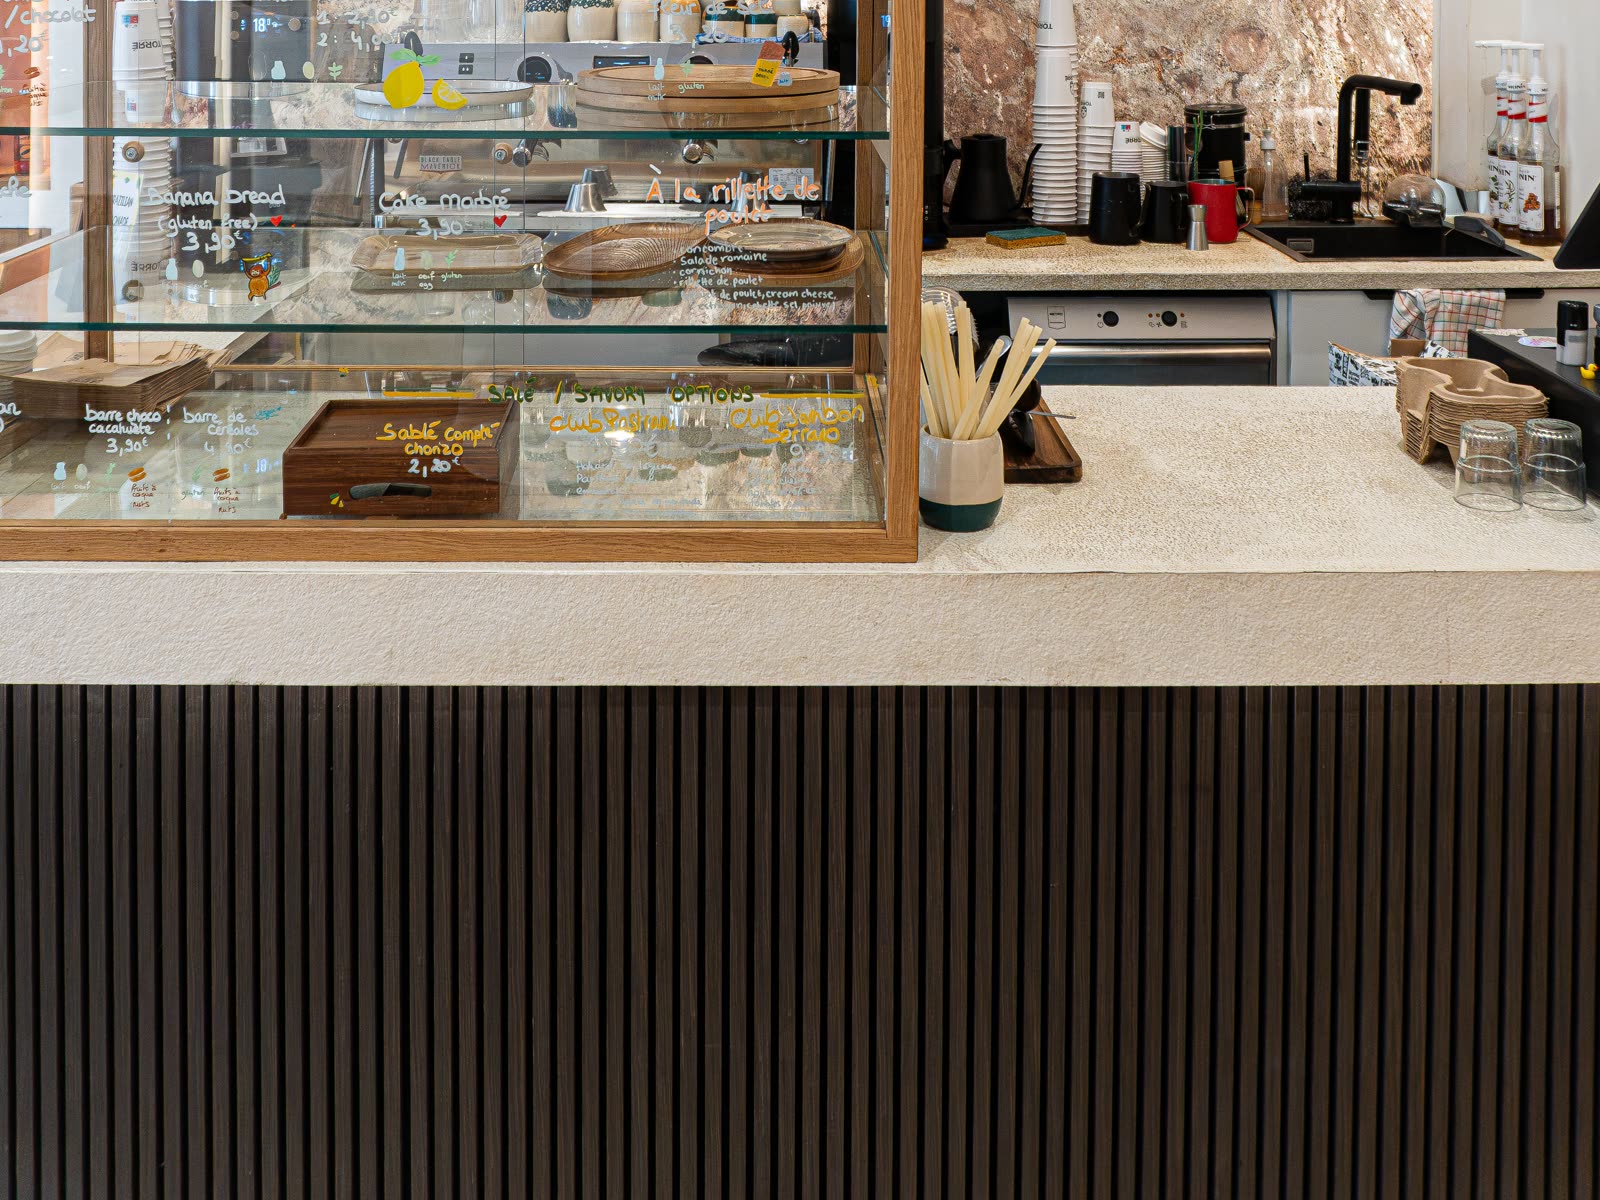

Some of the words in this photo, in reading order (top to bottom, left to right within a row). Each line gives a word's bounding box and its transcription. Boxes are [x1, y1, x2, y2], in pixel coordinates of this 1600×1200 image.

[706, 0, 727, 16] de
[1519, 173, 1535, 181] NIN
[793, 175, 821, 202] de
[379, 191, 428, 212] Cake
[573, 383, 646, 405] SAVORY
[670, 384, 755, 404] OPTIONS
[375, 419, 442, 441] Sablé
